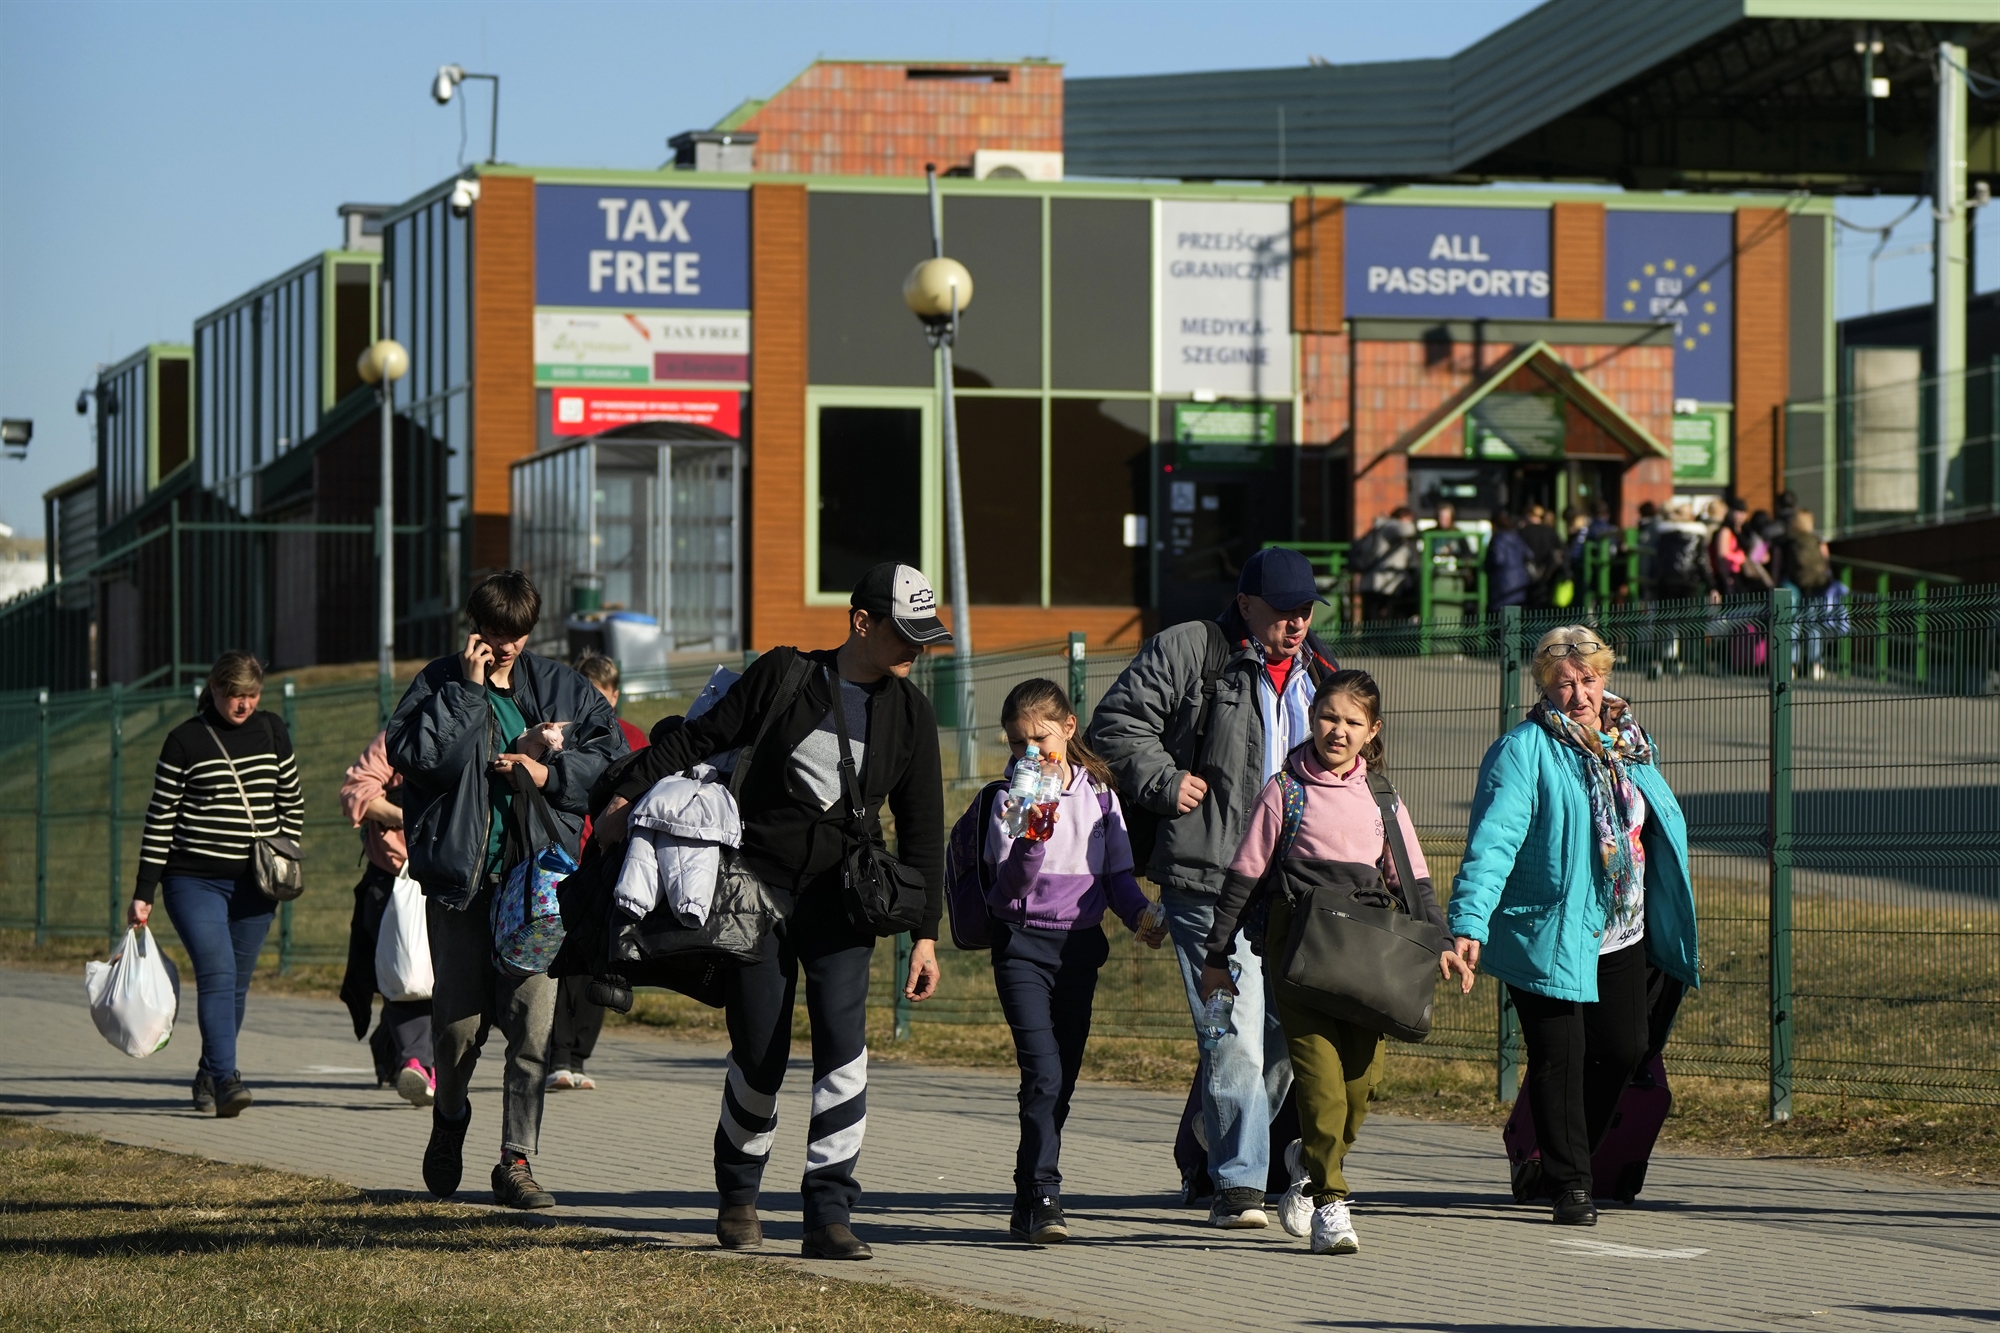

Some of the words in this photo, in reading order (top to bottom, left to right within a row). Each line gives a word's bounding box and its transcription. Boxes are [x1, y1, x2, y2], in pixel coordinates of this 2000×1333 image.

[599, 198, 691, 243] TAX
[1428, 233, 1490, 262] ALL
[588, 249, 701, 295] FREE
[1367, 266, 1550, 299] PASSPORTS
[1655, 277, 1683, 296] EU
[663, 325, 695, 339] TAX
[699, 325, 741, 340] FREE
